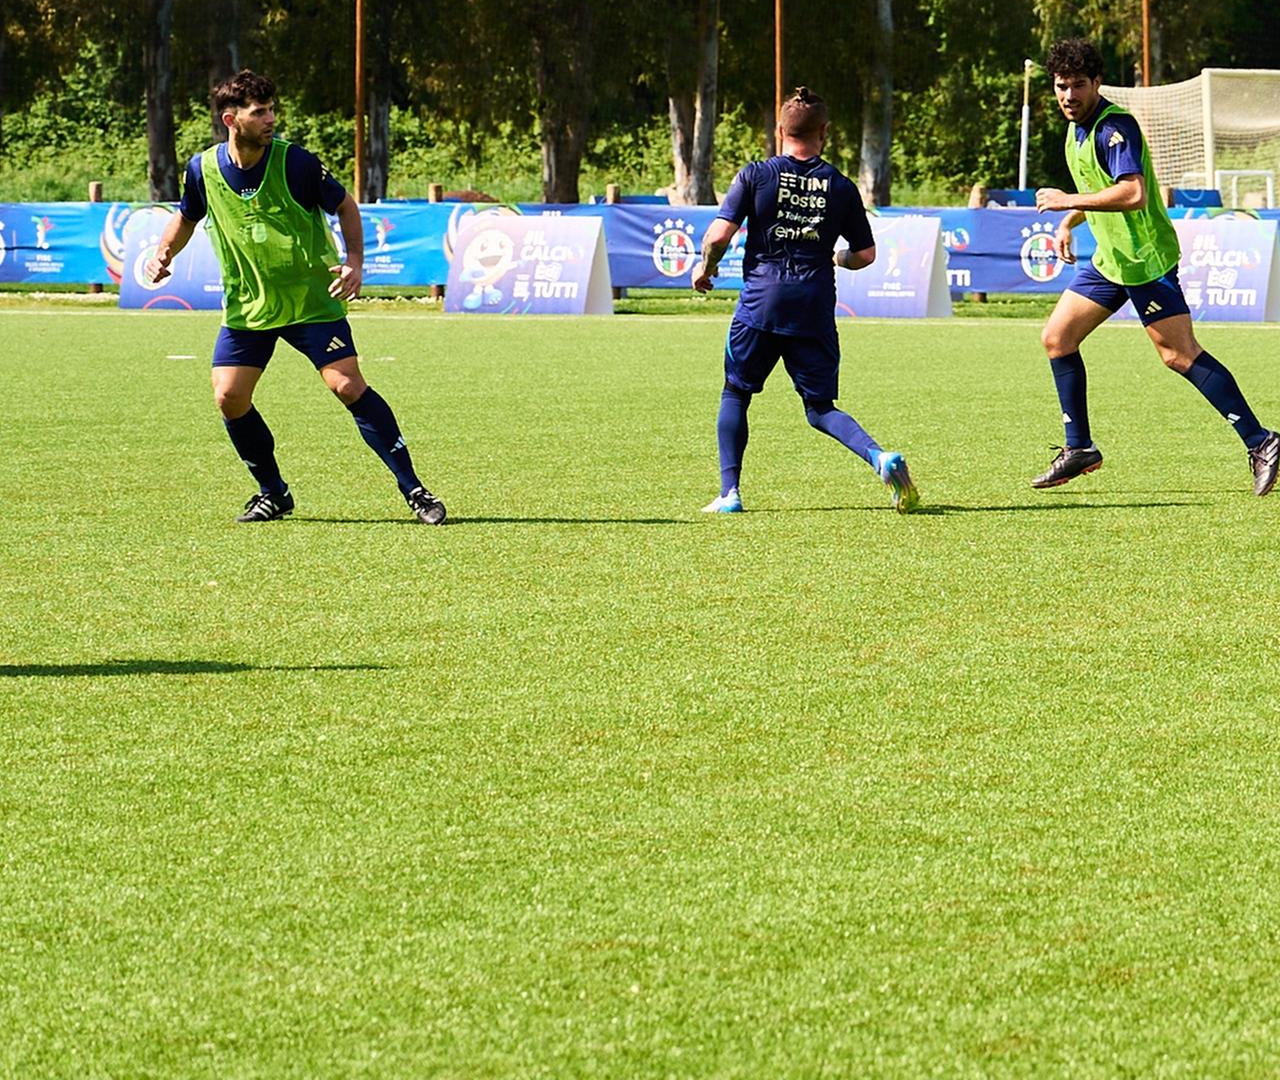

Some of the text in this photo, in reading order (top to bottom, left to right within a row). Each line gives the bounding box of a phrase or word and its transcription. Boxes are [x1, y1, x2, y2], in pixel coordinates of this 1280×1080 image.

[798, 175, 828, 192] TIM
[778, 187, 826, 209] Poste
[775, 226, 801, 240] eni
[1192, 235, 1218, 250] #IL
[533, 281, 579, 298] TUTTI
[1206, 289, 1256, 306] TUTTI
